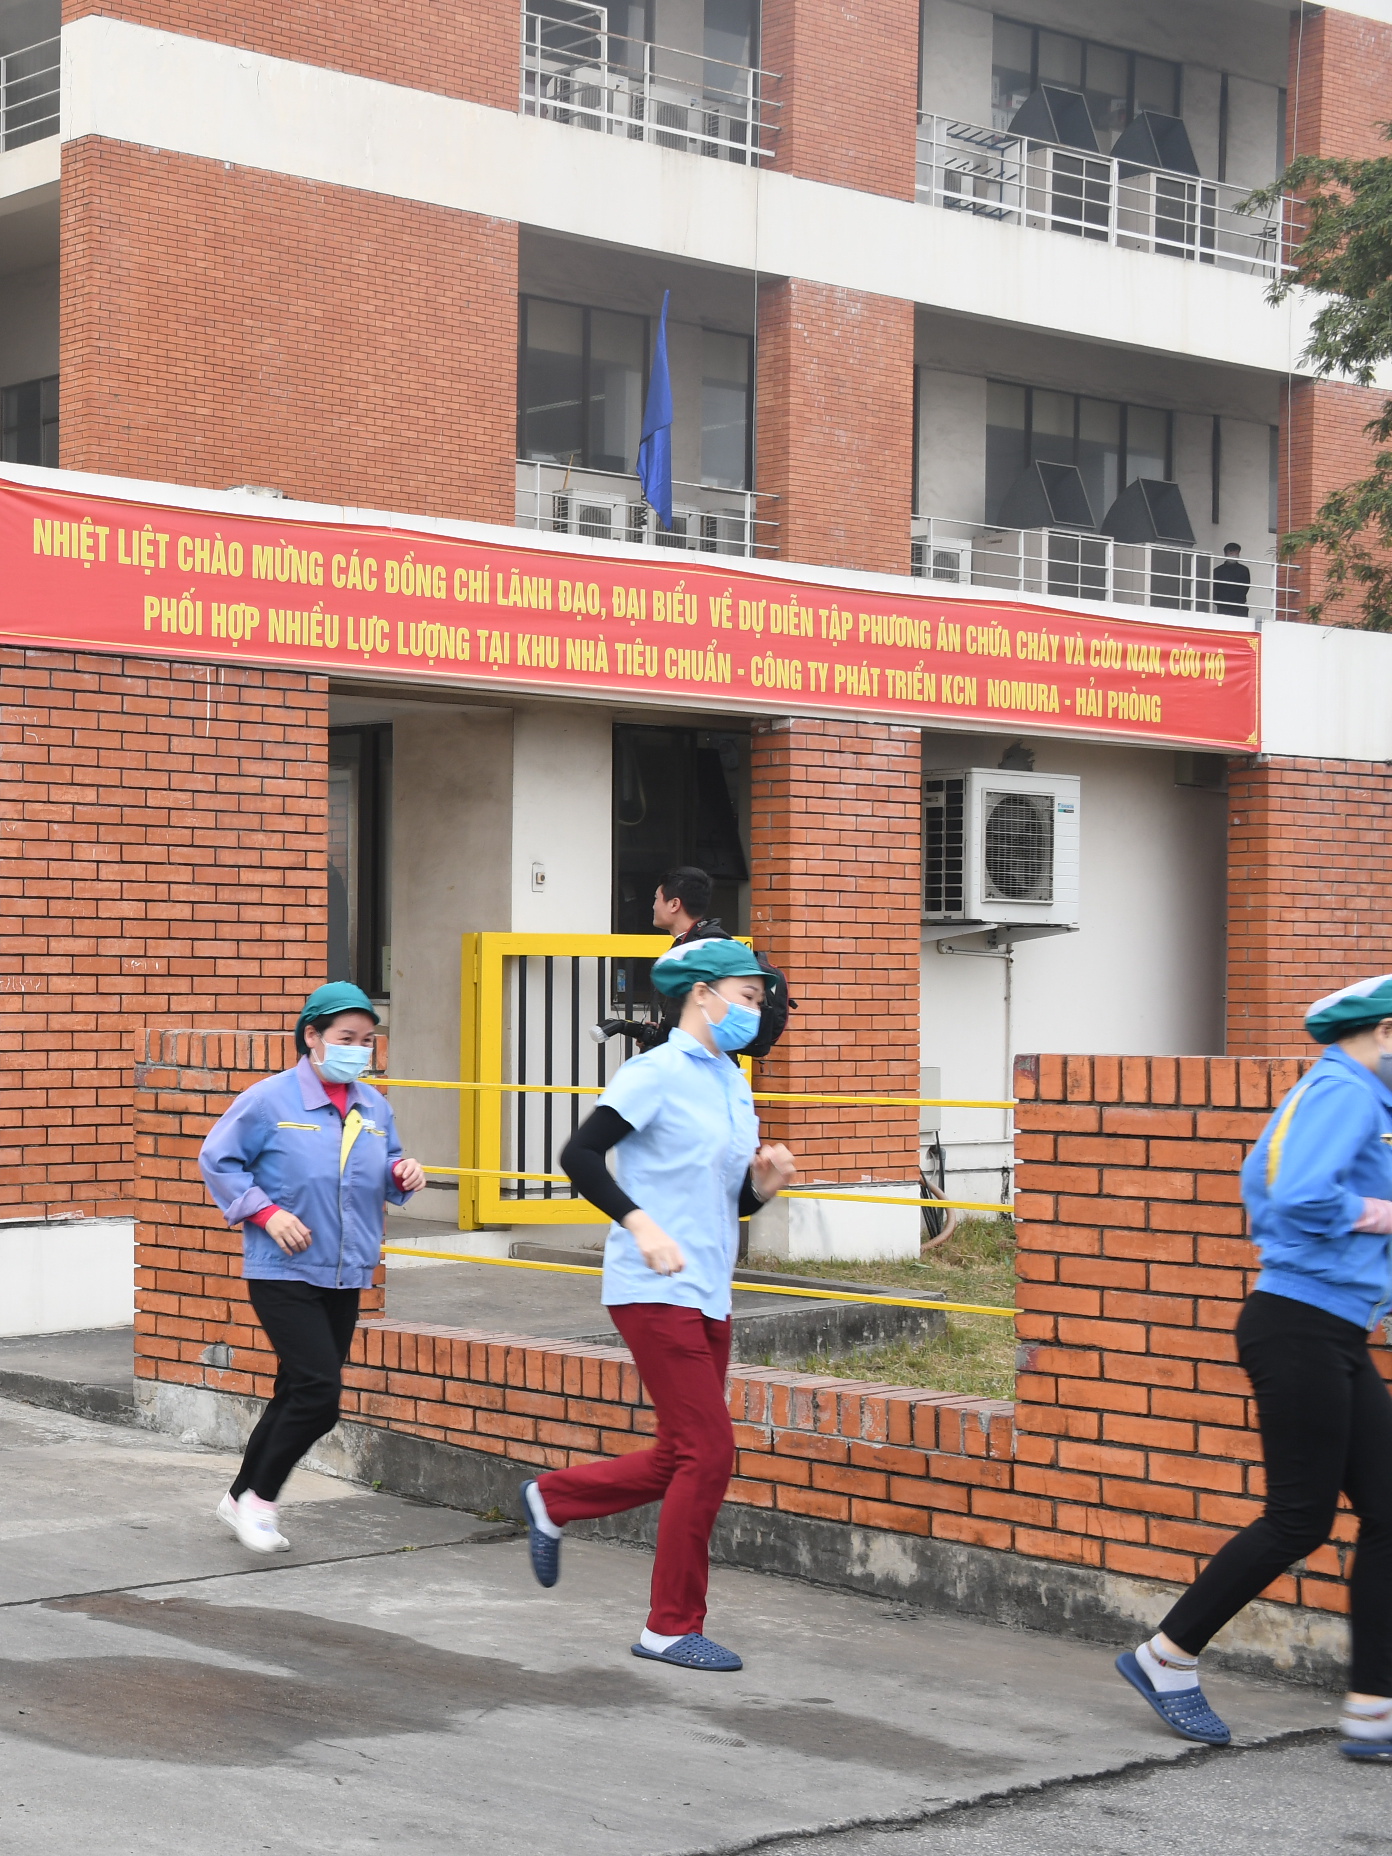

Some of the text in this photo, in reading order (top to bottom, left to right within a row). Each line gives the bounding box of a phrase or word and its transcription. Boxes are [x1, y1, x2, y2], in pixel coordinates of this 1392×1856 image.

[33, 516, 1226, 687] NHIỆT LIỆT CHÀO MỪNG CÁC ĐỒNG CHÍ LÃNH ĐẠO, ĐẠI BIỂU VỀ DỰ DIỄN TẬP PHƯƠNG ÁN CHỮA CHÁY VÀ CỨU NẠN, CỨU HỘ
[144, 587, 1162, 723] PHỐI HỢP NHIỀU LỰC LƯỢNG TẠI KHU NHÀ TIÊU CHUẨN - CÔNG TY PHÁT TRIỂN KCN NOMURA - HẢI PHÒNG
